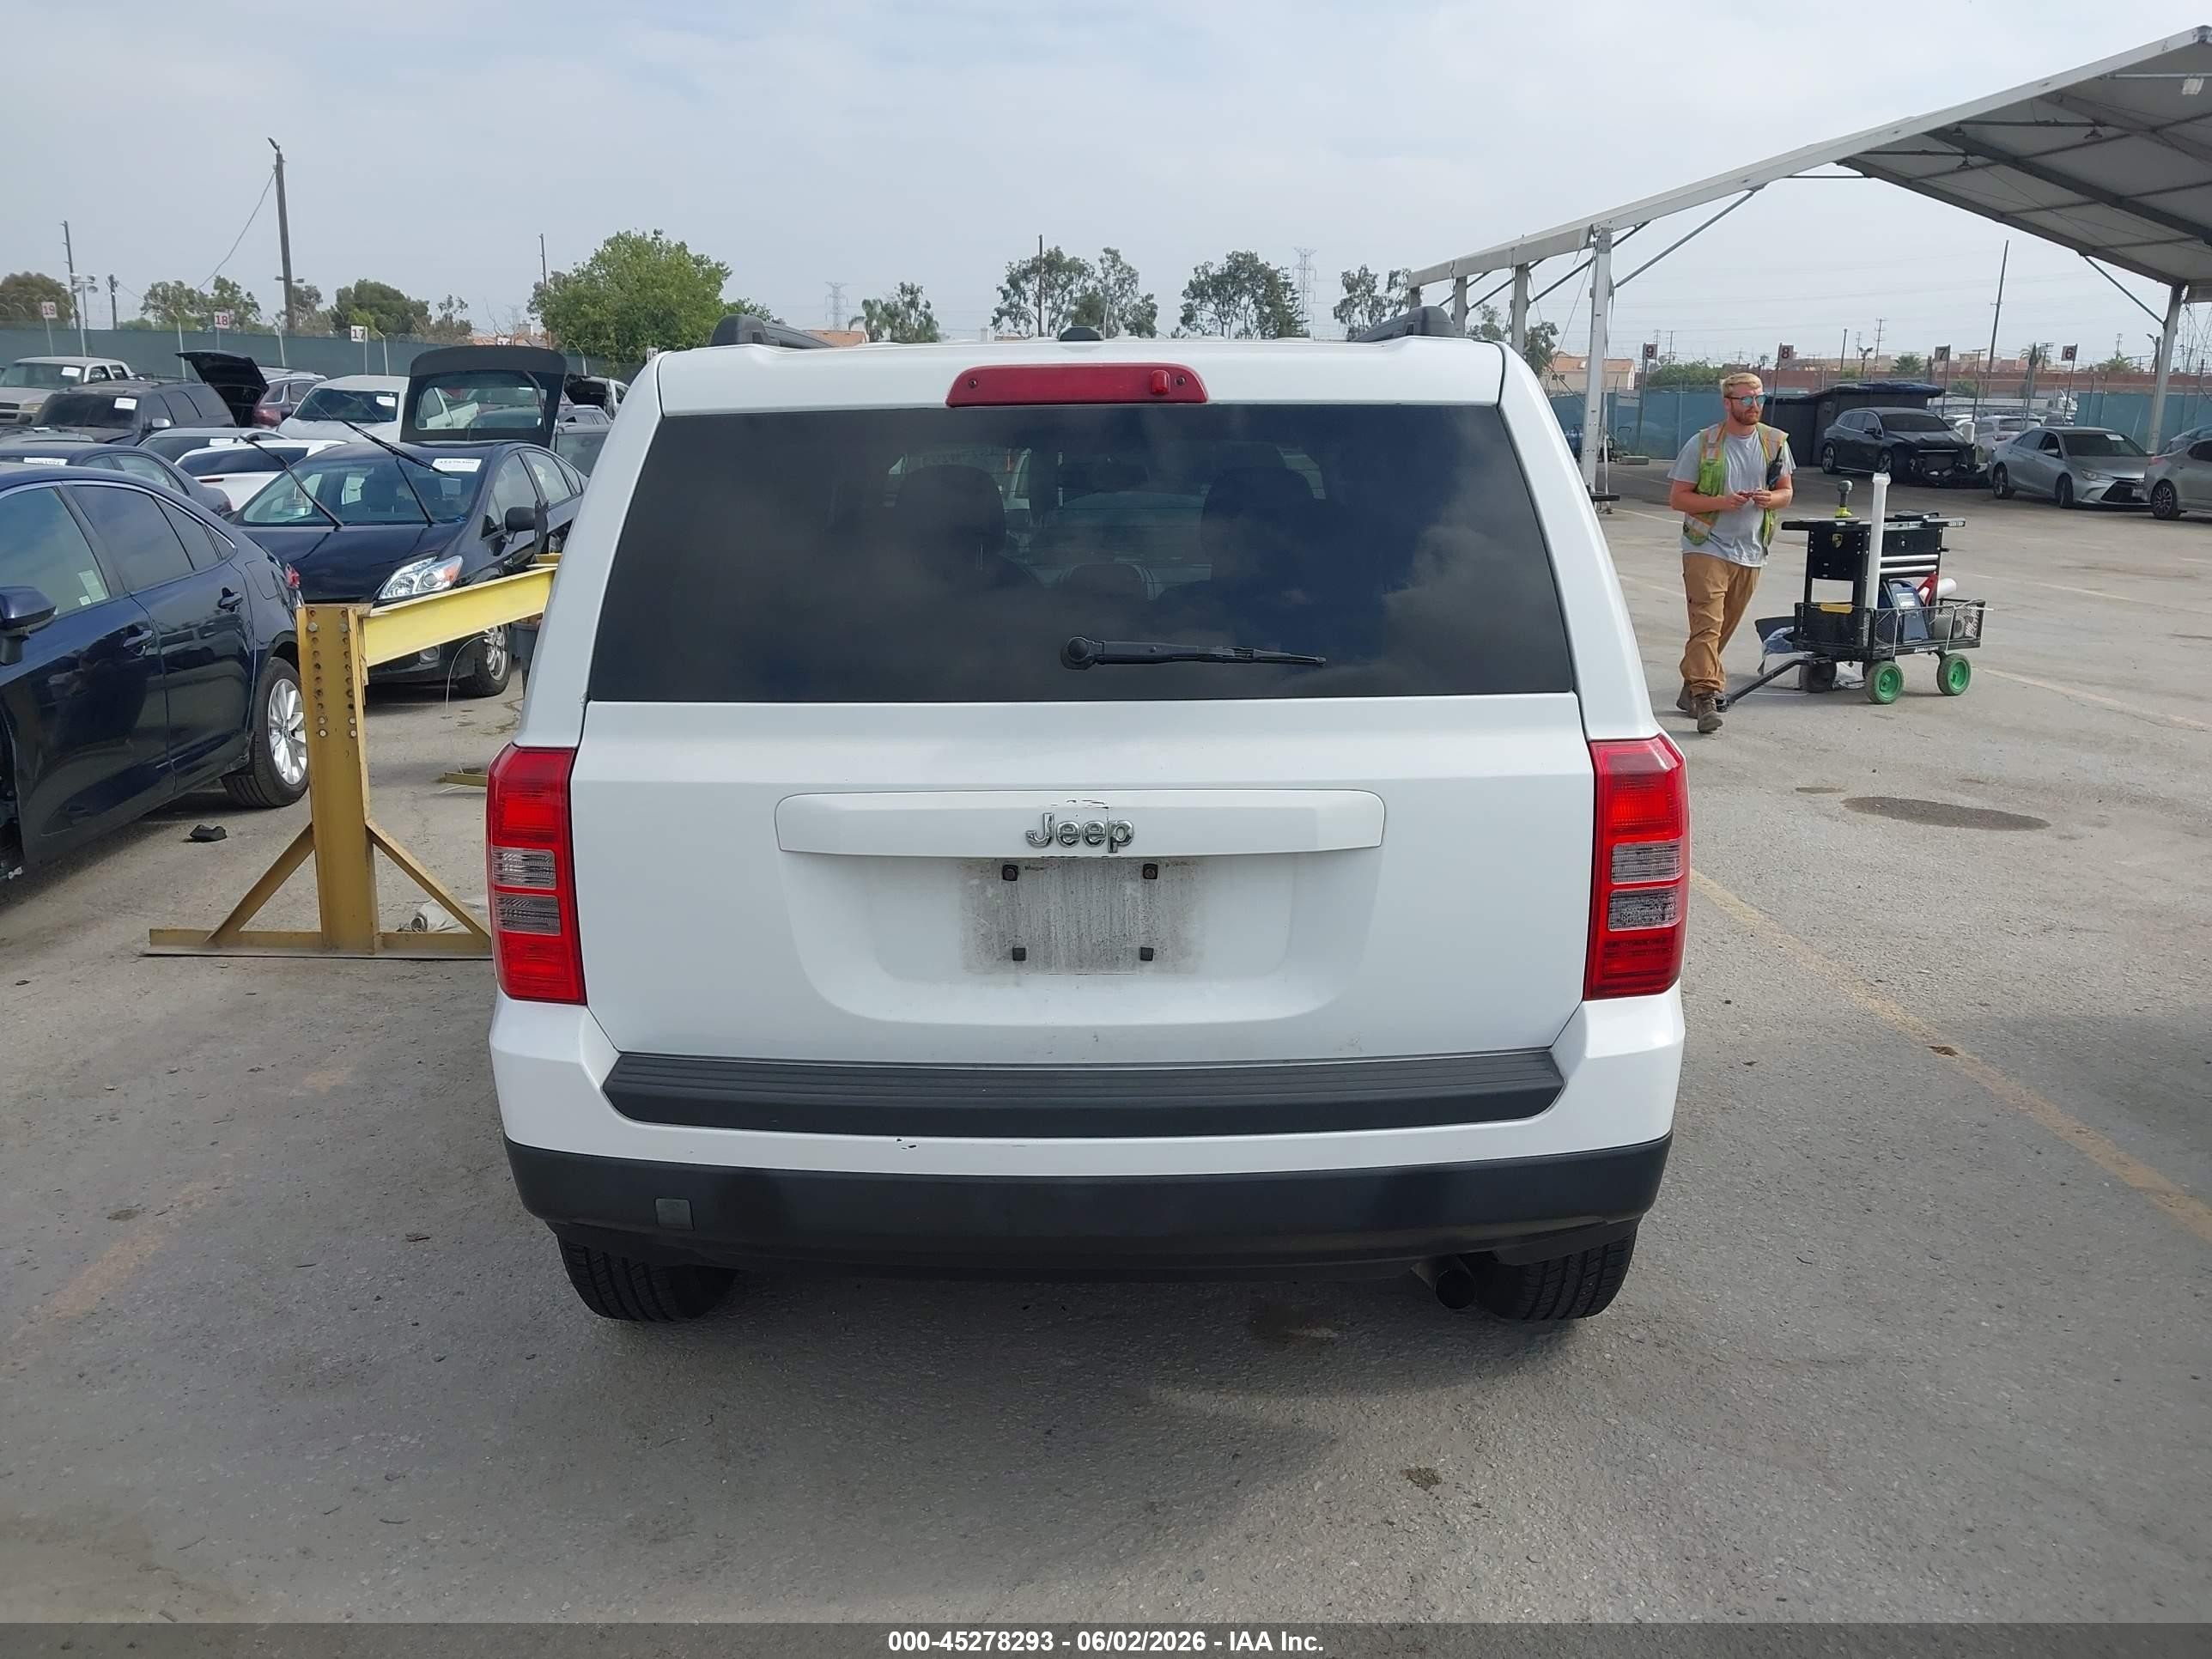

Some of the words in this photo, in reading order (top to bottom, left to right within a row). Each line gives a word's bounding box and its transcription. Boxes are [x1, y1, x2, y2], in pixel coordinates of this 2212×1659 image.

[43, 305, 56, 315] 19
[216, 315, 228, 325] 18
[351, 329, 365, 339] 17
[1645, 345, 1654, 358] 9
[1781, 347, 1790, 359] 8
[1936, 348, 1947, 360] 7
[2064, 348, 2074, 360] 6
[1025, 812, 1134, 853] Jeep
